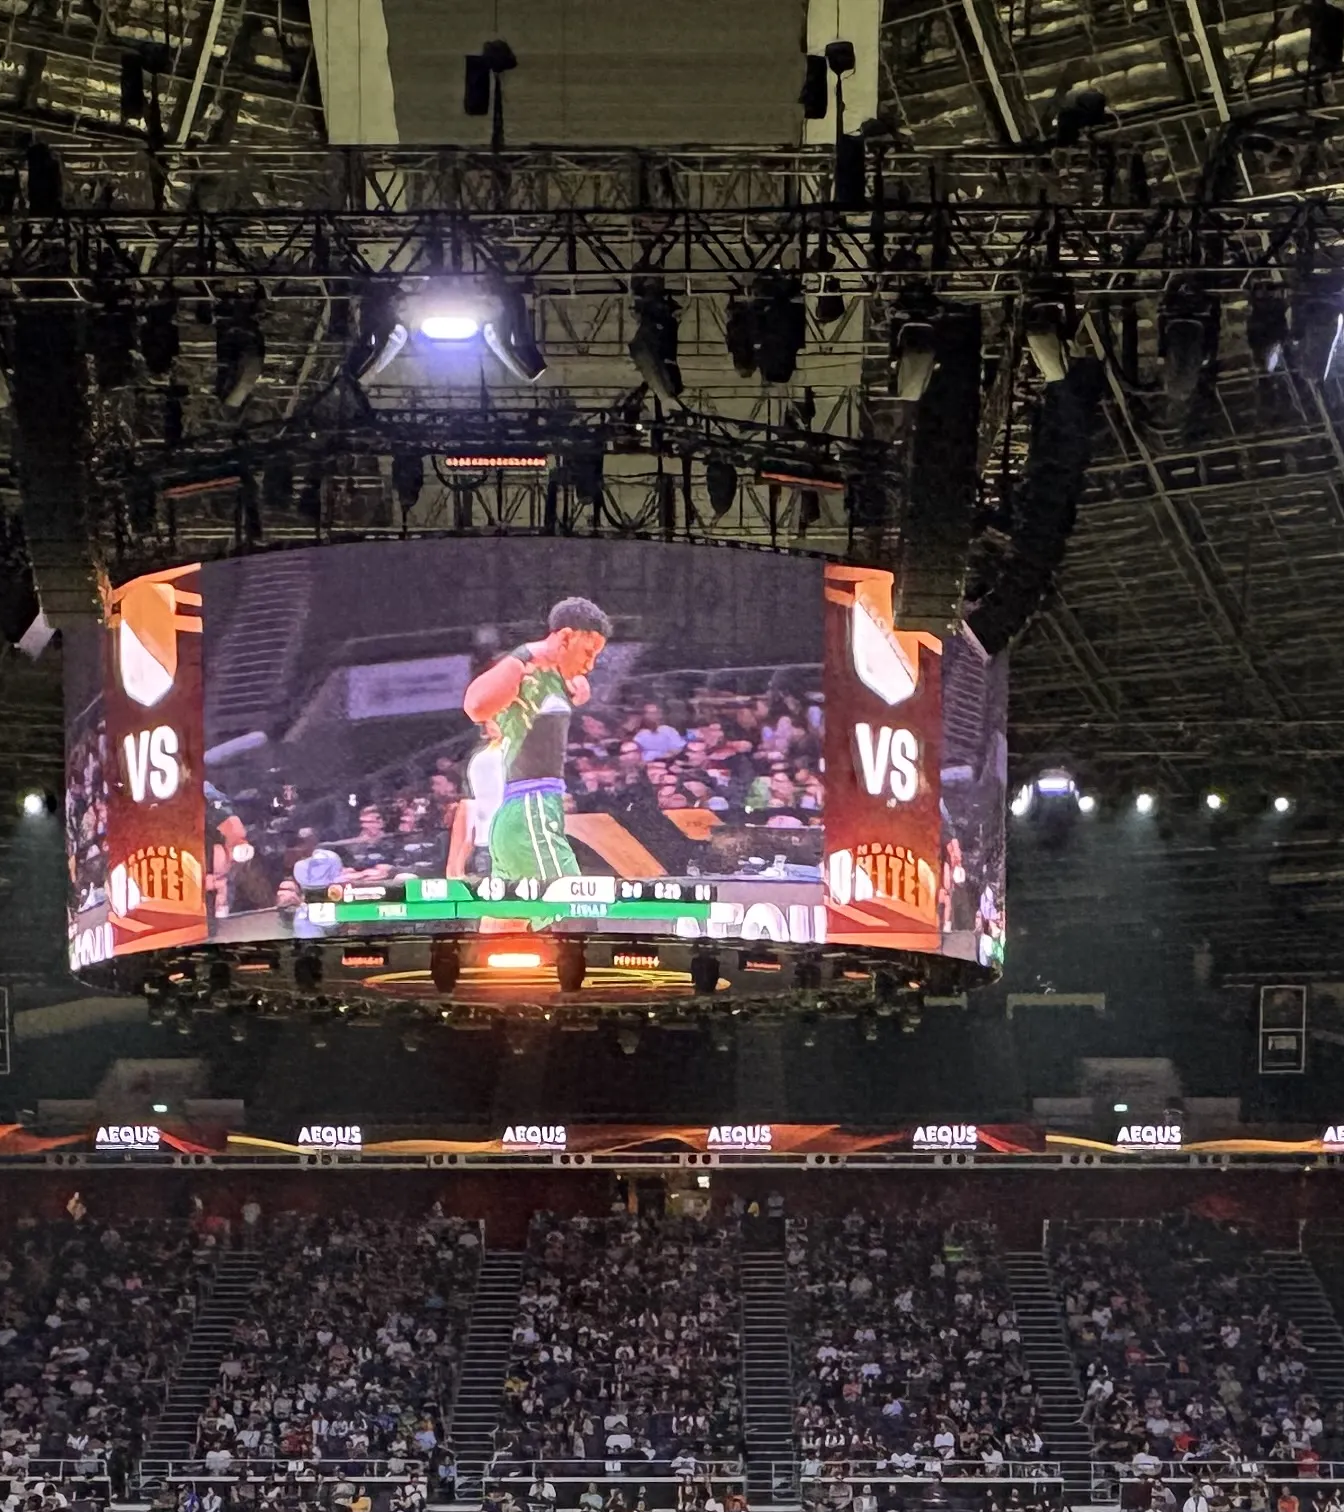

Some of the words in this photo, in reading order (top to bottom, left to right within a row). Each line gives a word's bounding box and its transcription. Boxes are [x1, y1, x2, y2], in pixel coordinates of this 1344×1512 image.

[124, 725, 179, 803] VS
[856, 722, 918, 801] VS
[477, 876, 505, 900] 49
[515, 876, 538, 900] 41
[570, 882, 596, 896] GLU
[96, 1125, 160, 1143] AEQUS
[298, 1125, 361, 1143] AEQUS
[502, 1125, 566, 1143] AEQUS
[708, 1125, 773, 1143] AEQUS
[913, 1125, 978, 1143] AEQUS
[1117, 1125, 1181, 1143] AEQUS
